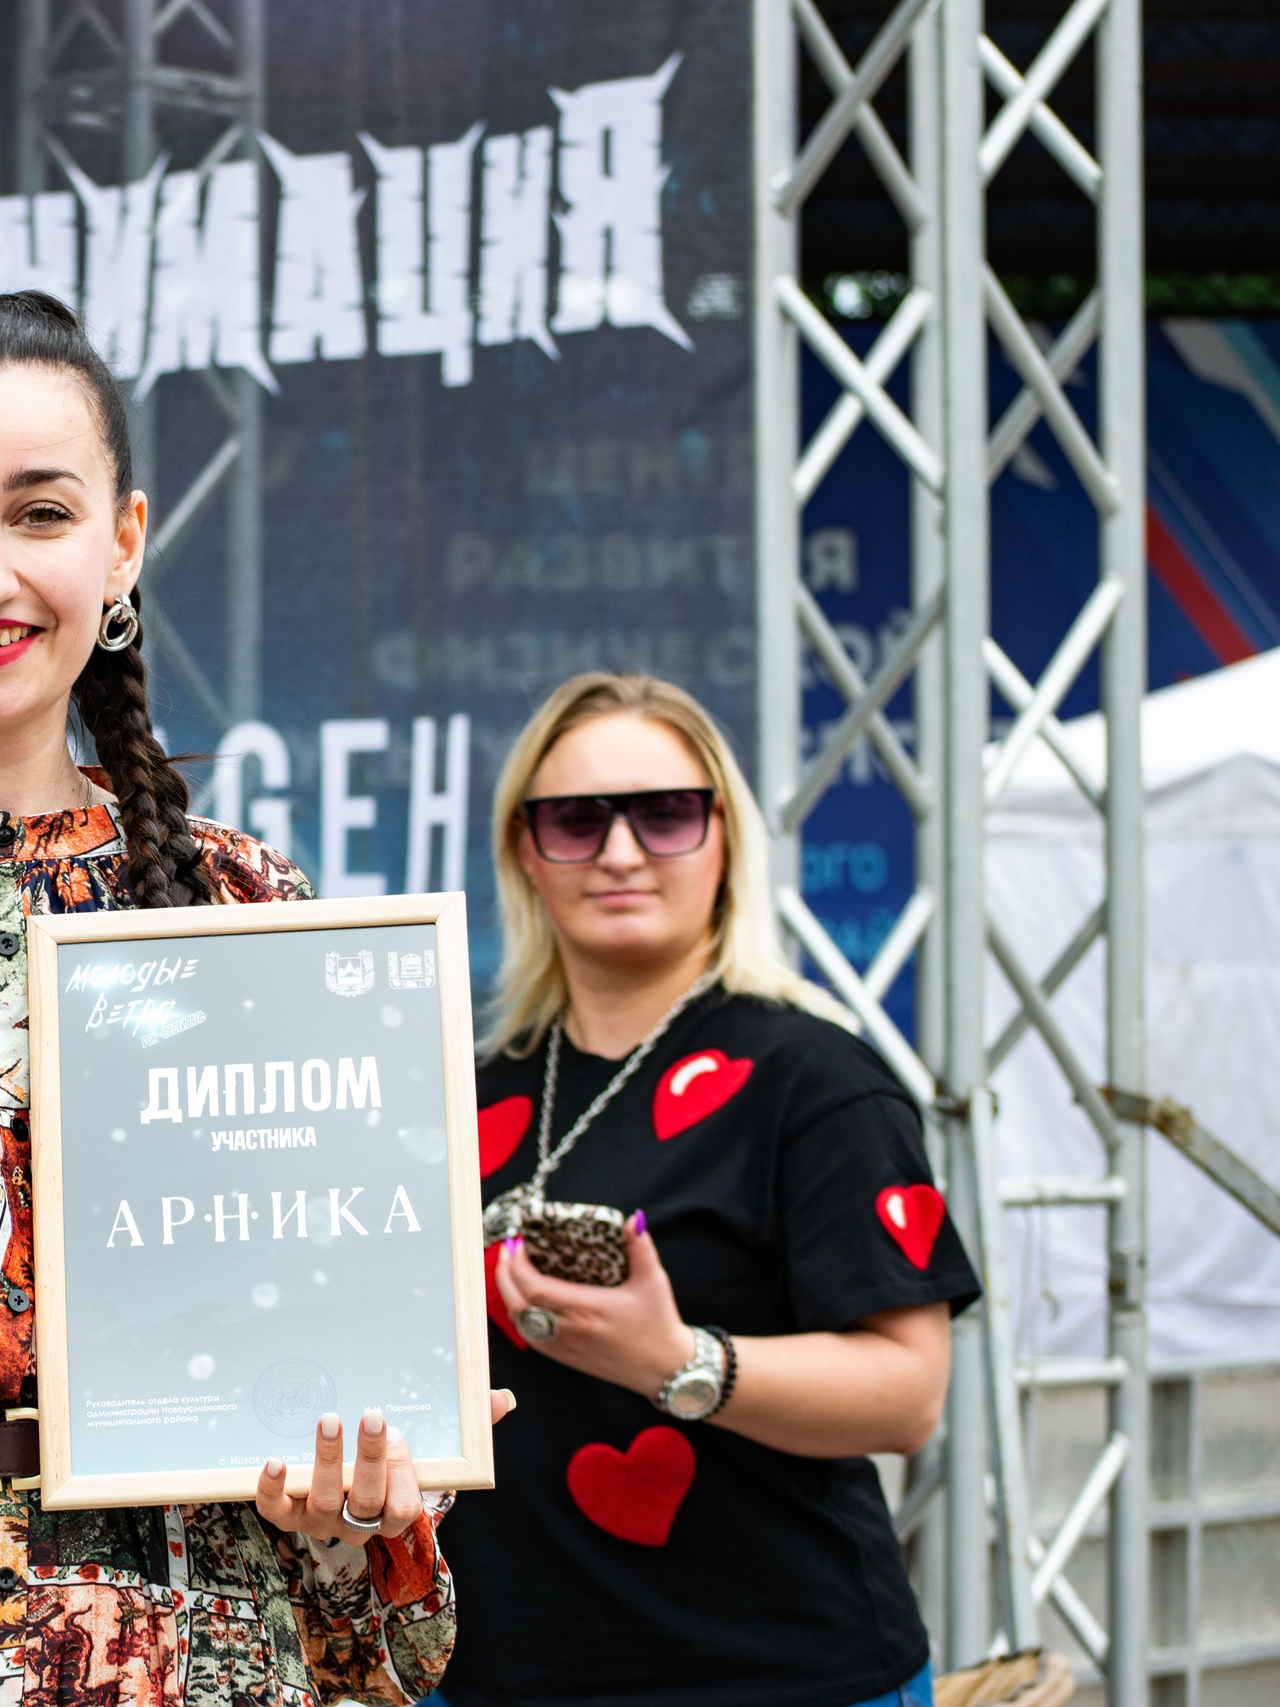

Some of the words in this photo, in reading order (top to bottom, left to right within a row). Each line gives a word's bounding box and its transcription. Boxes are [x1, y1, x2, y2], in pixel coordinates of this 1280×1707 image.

[140, 1056, 382, 1124] ДИПЛОМ
[211, 1126, 317, 1152] УЧАСТНИКА
[86, 1399, 146, 1409] Руководитель
[147, 1397, 179, 1405] отдела
[180, 1395, 220, 1404] культуры
[386, 1404, 431, 1413] Паринова
[86, 1407, 160, 1418] администрации
[161, 1403, 237, 1414] Новоусманского
[86, 1417, 161, 1429] муниципального
[163, 1414, 198, 1425] района
[230, 1455, 261, 1465] Новая
